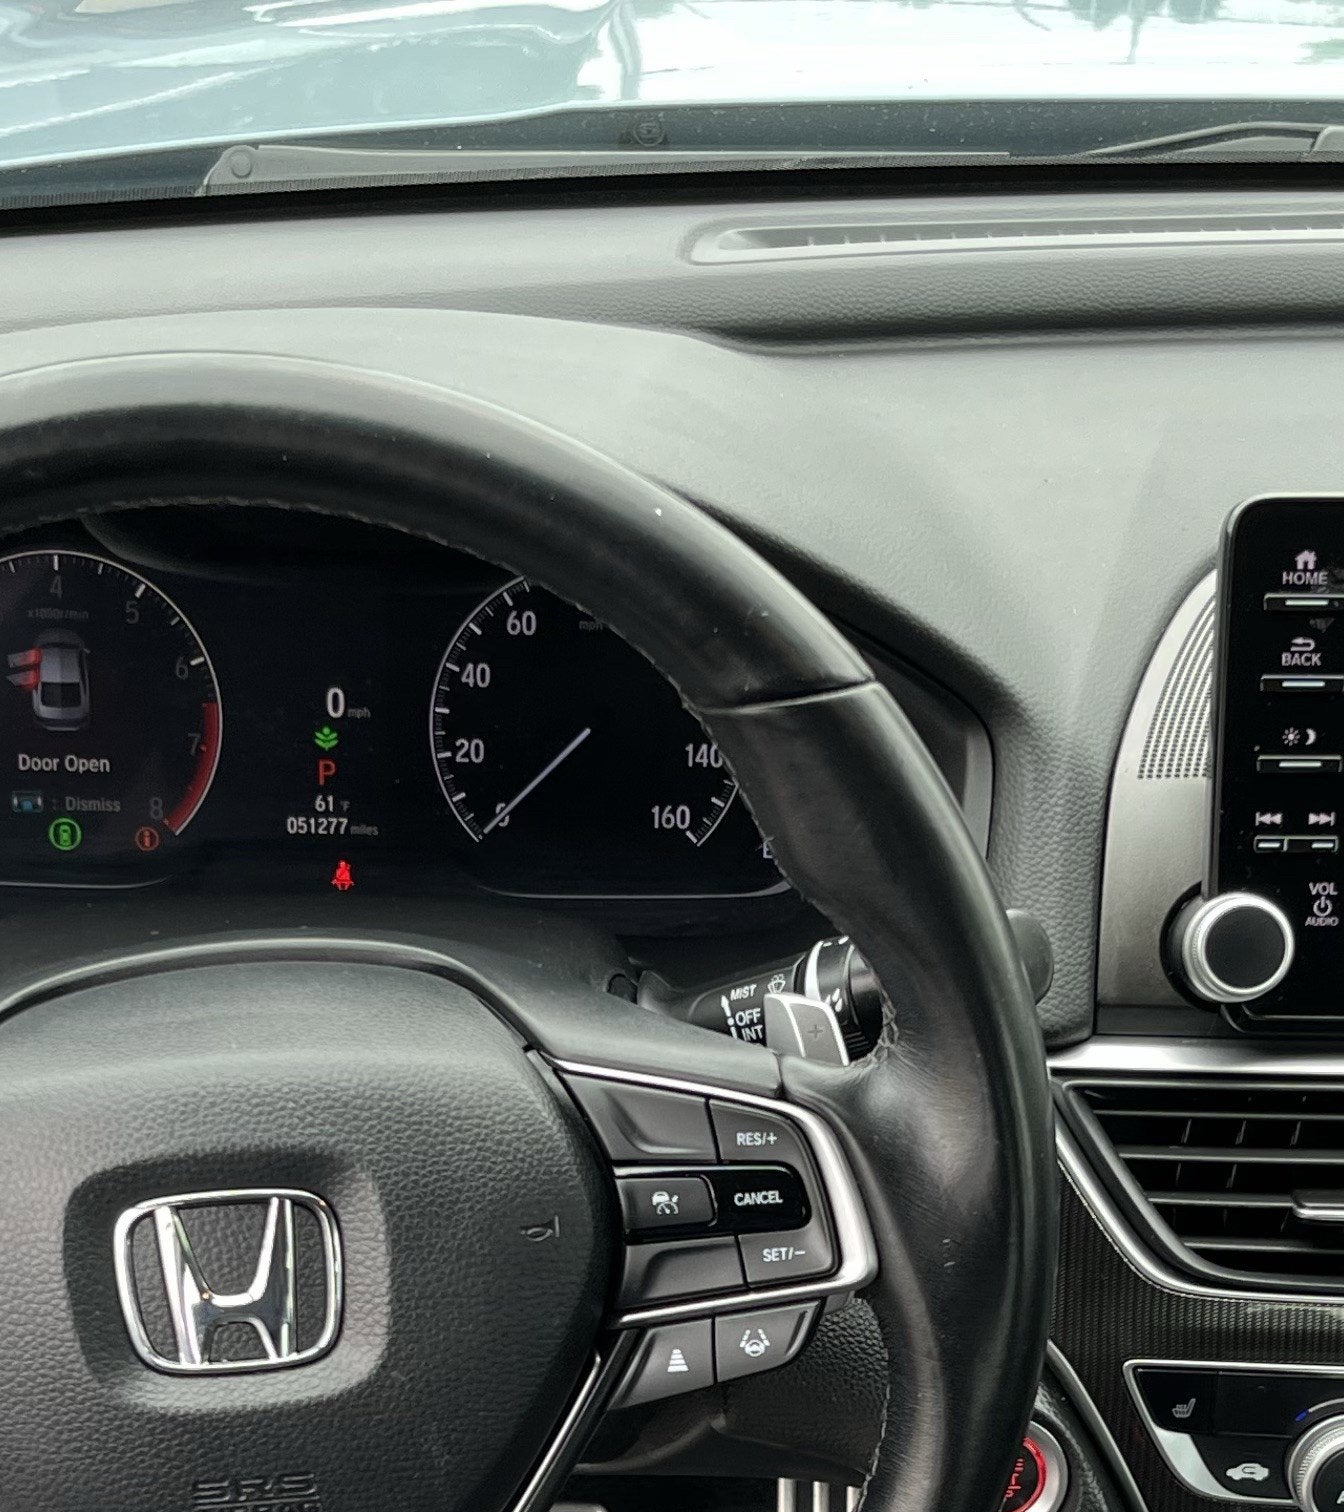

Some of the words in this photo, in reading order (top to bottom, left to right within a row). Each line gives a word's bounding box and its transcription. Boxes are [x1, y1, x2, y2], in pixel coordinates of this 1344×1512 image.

[1282, 572, 1328, 585] HOME
[506, 610, 537, 635] 60
[175, 657, 189, 680] 6
[1282, 653, 1322, 667] BACK
[461, 663, 491, 688] 40
[326, 687, 345, 718] 0
[347, 706, 371, 718] mph
[455, 738, 484, 763] 20
[685, 743, 723, 768] 140
[18, 753, 59, 772] Door
[64, 754, 110, 774] Open
[318, 758, 336, 785] P
[65, 796, 121, 813] Dismiss
[314, 795, 333, 812] 61
[652, 805, 691, 829] 160
[286, 817, 348, 835] 051277
[350, 824, 379, 836] miles
[1309, 882, 1338, 896] VOL
[1305, 916, 1339, 927] AUDIO
[730, 984, 757, 1001] MIST
[735, 1008, 761, 1026] OFF
[741, 1025, 763, 1041] INT
[736, 1131, 777, 1147] RES/+
[734, 1191, 783, 1206] CANCEL
